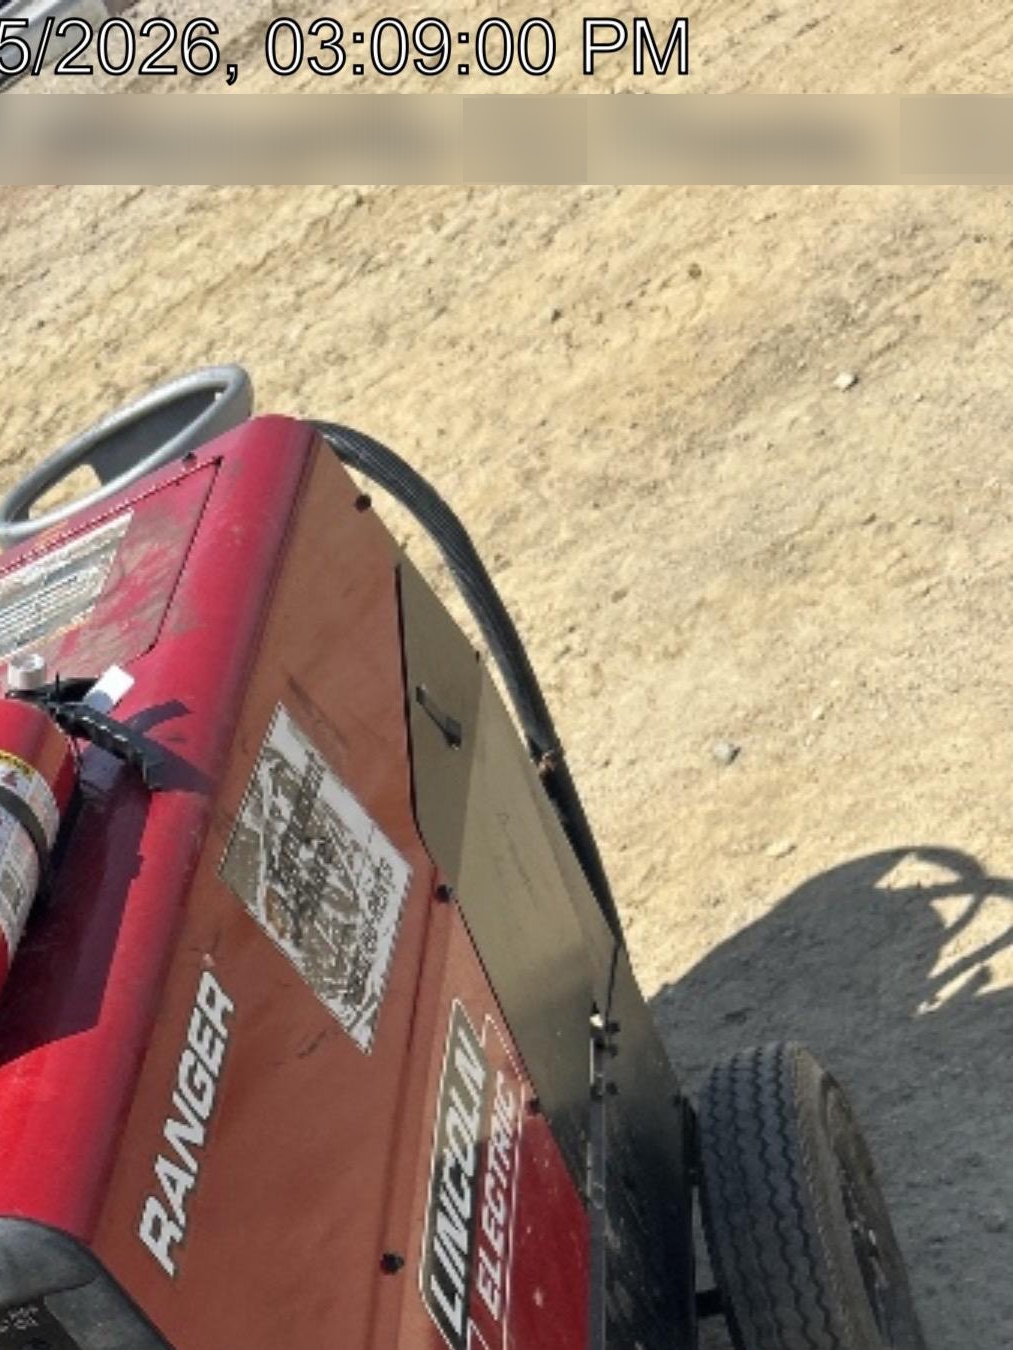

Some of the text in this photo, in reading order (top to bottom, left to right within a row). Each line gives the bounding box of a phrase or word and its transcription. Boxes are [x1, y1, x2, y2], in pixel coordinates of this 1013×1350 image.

[139, 971, 234, 1277] RANGER
[431, 1028, 486, 1336] LINCOLN
[476, 1070, 517, 1321] ELECTRIC
